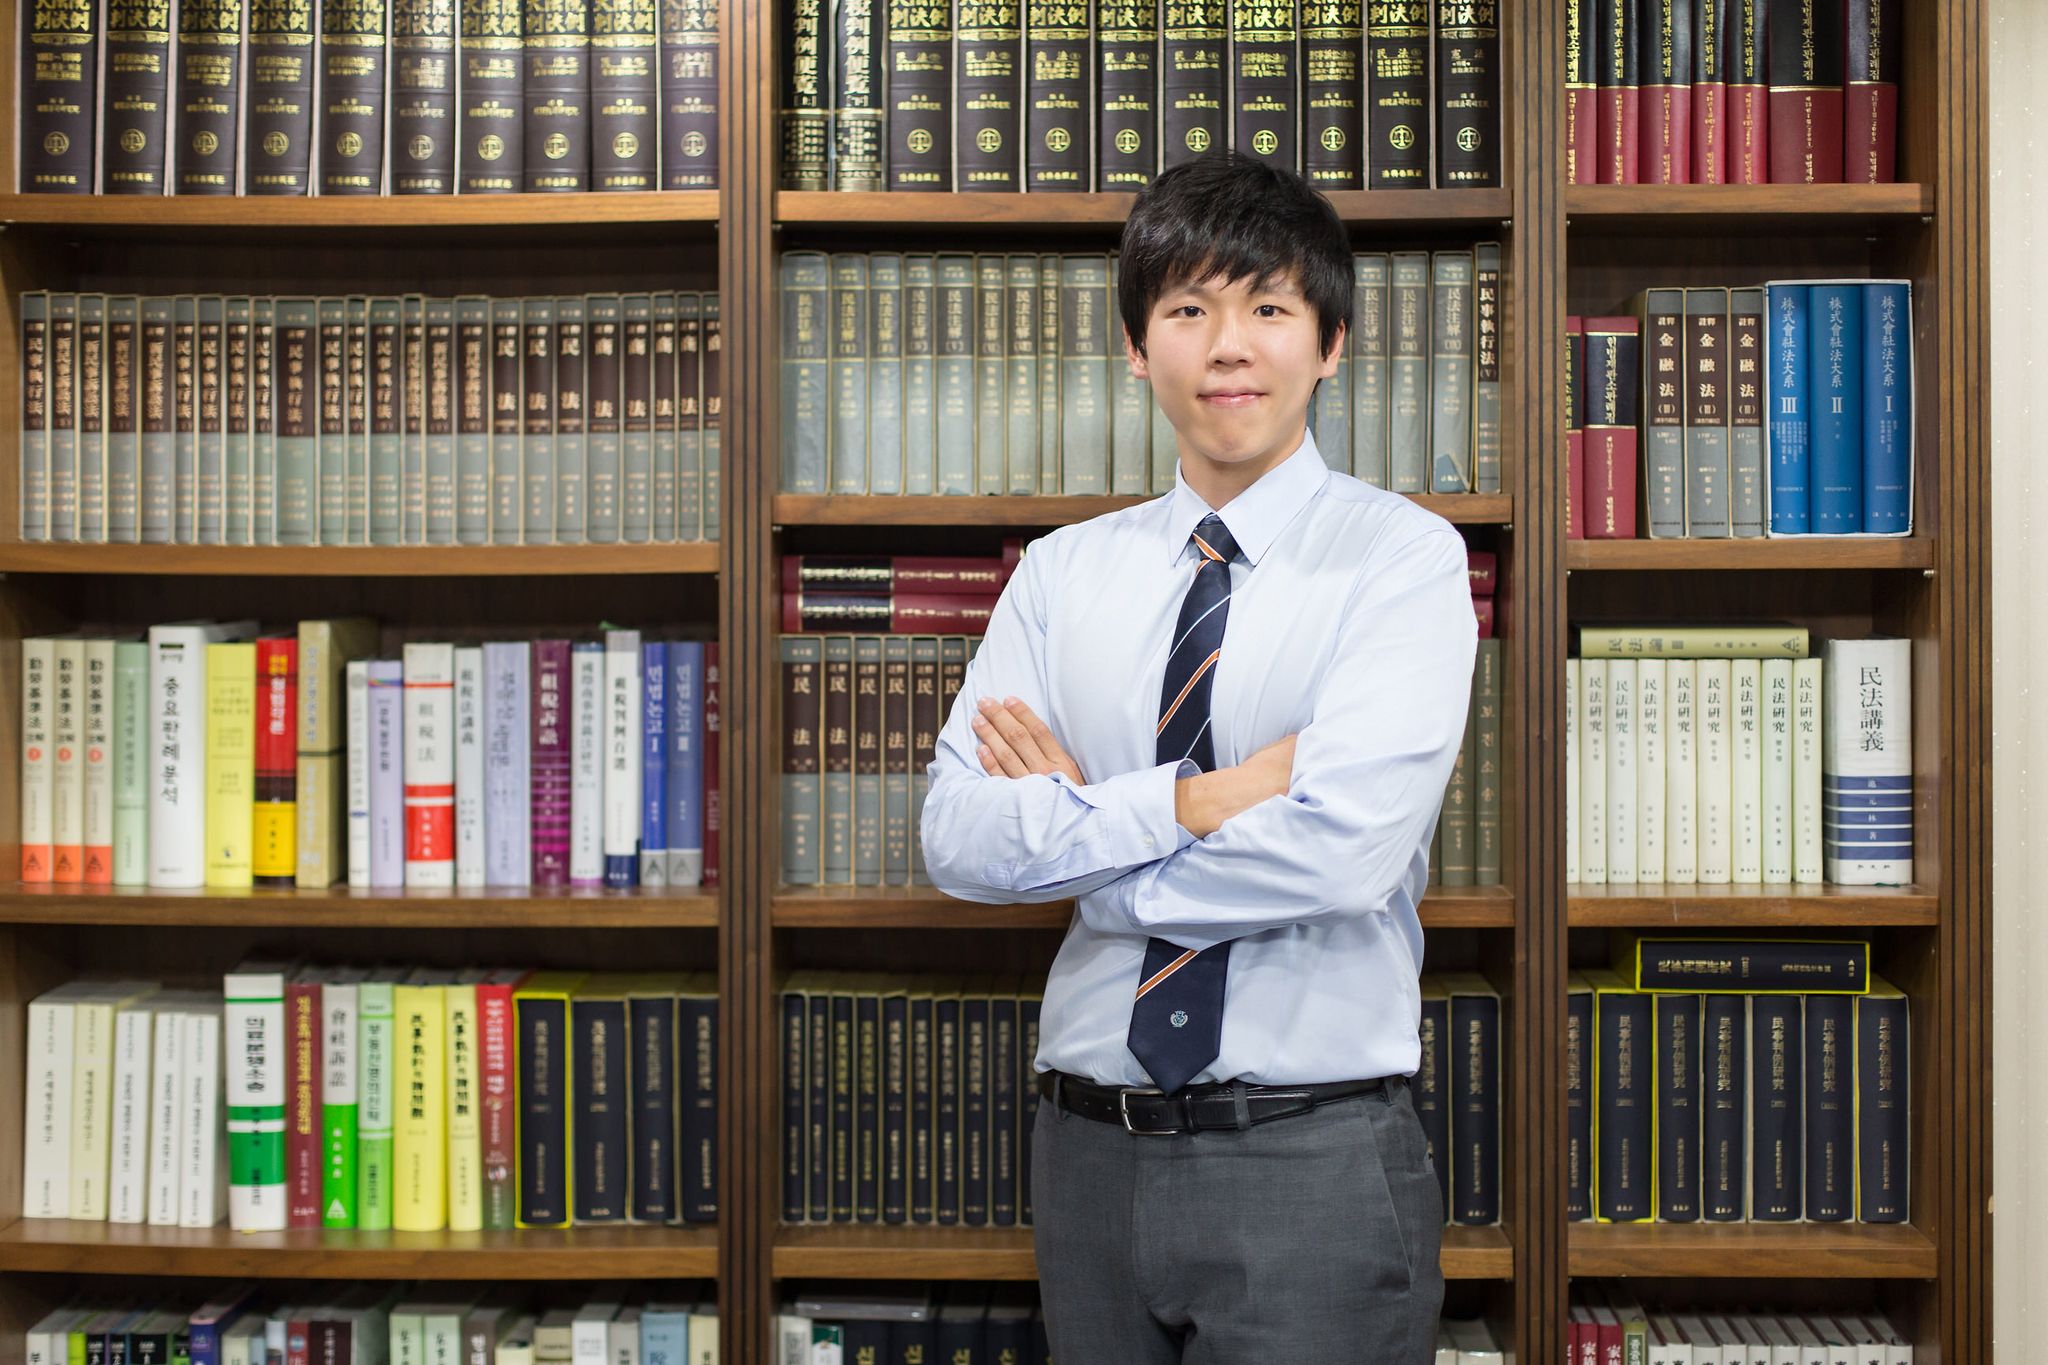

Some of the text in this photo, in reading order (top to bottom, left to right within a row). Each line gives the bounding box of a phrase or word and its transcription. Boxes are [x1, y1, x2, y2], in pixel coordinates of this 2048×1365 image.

[890, 7, 948, 29] 判決例
[958, 7, 1017, 29] 判決例
[1029, 7, 1087, 28] 判決例
[1103, 7, 1157, 29] 判決例
[1166, 5, 1224, 27] 判決例
[1234, 6, 1293, 29] 判決例
[1302, 6, 1360, 27] 判決例
[1370, 4, 1428, 26] 判決例
[1440, 5, 1493, 27] 判決例
[1780, 296, 1796, 390] 株式會社法大系
[1880, 294, 1897, 413] 株式會社法大系 I
[1659, 332, 1675, 398] 金融法
[1699, 332, 1715, 398] 金融法
[1740, 332, 1755, 398] 金融法
[1828, 295, 1844, 414] 株式會社法大系 II
[1780, 396, 1798, 414] III
[1859, 666, 1884, 752] 民法講義
